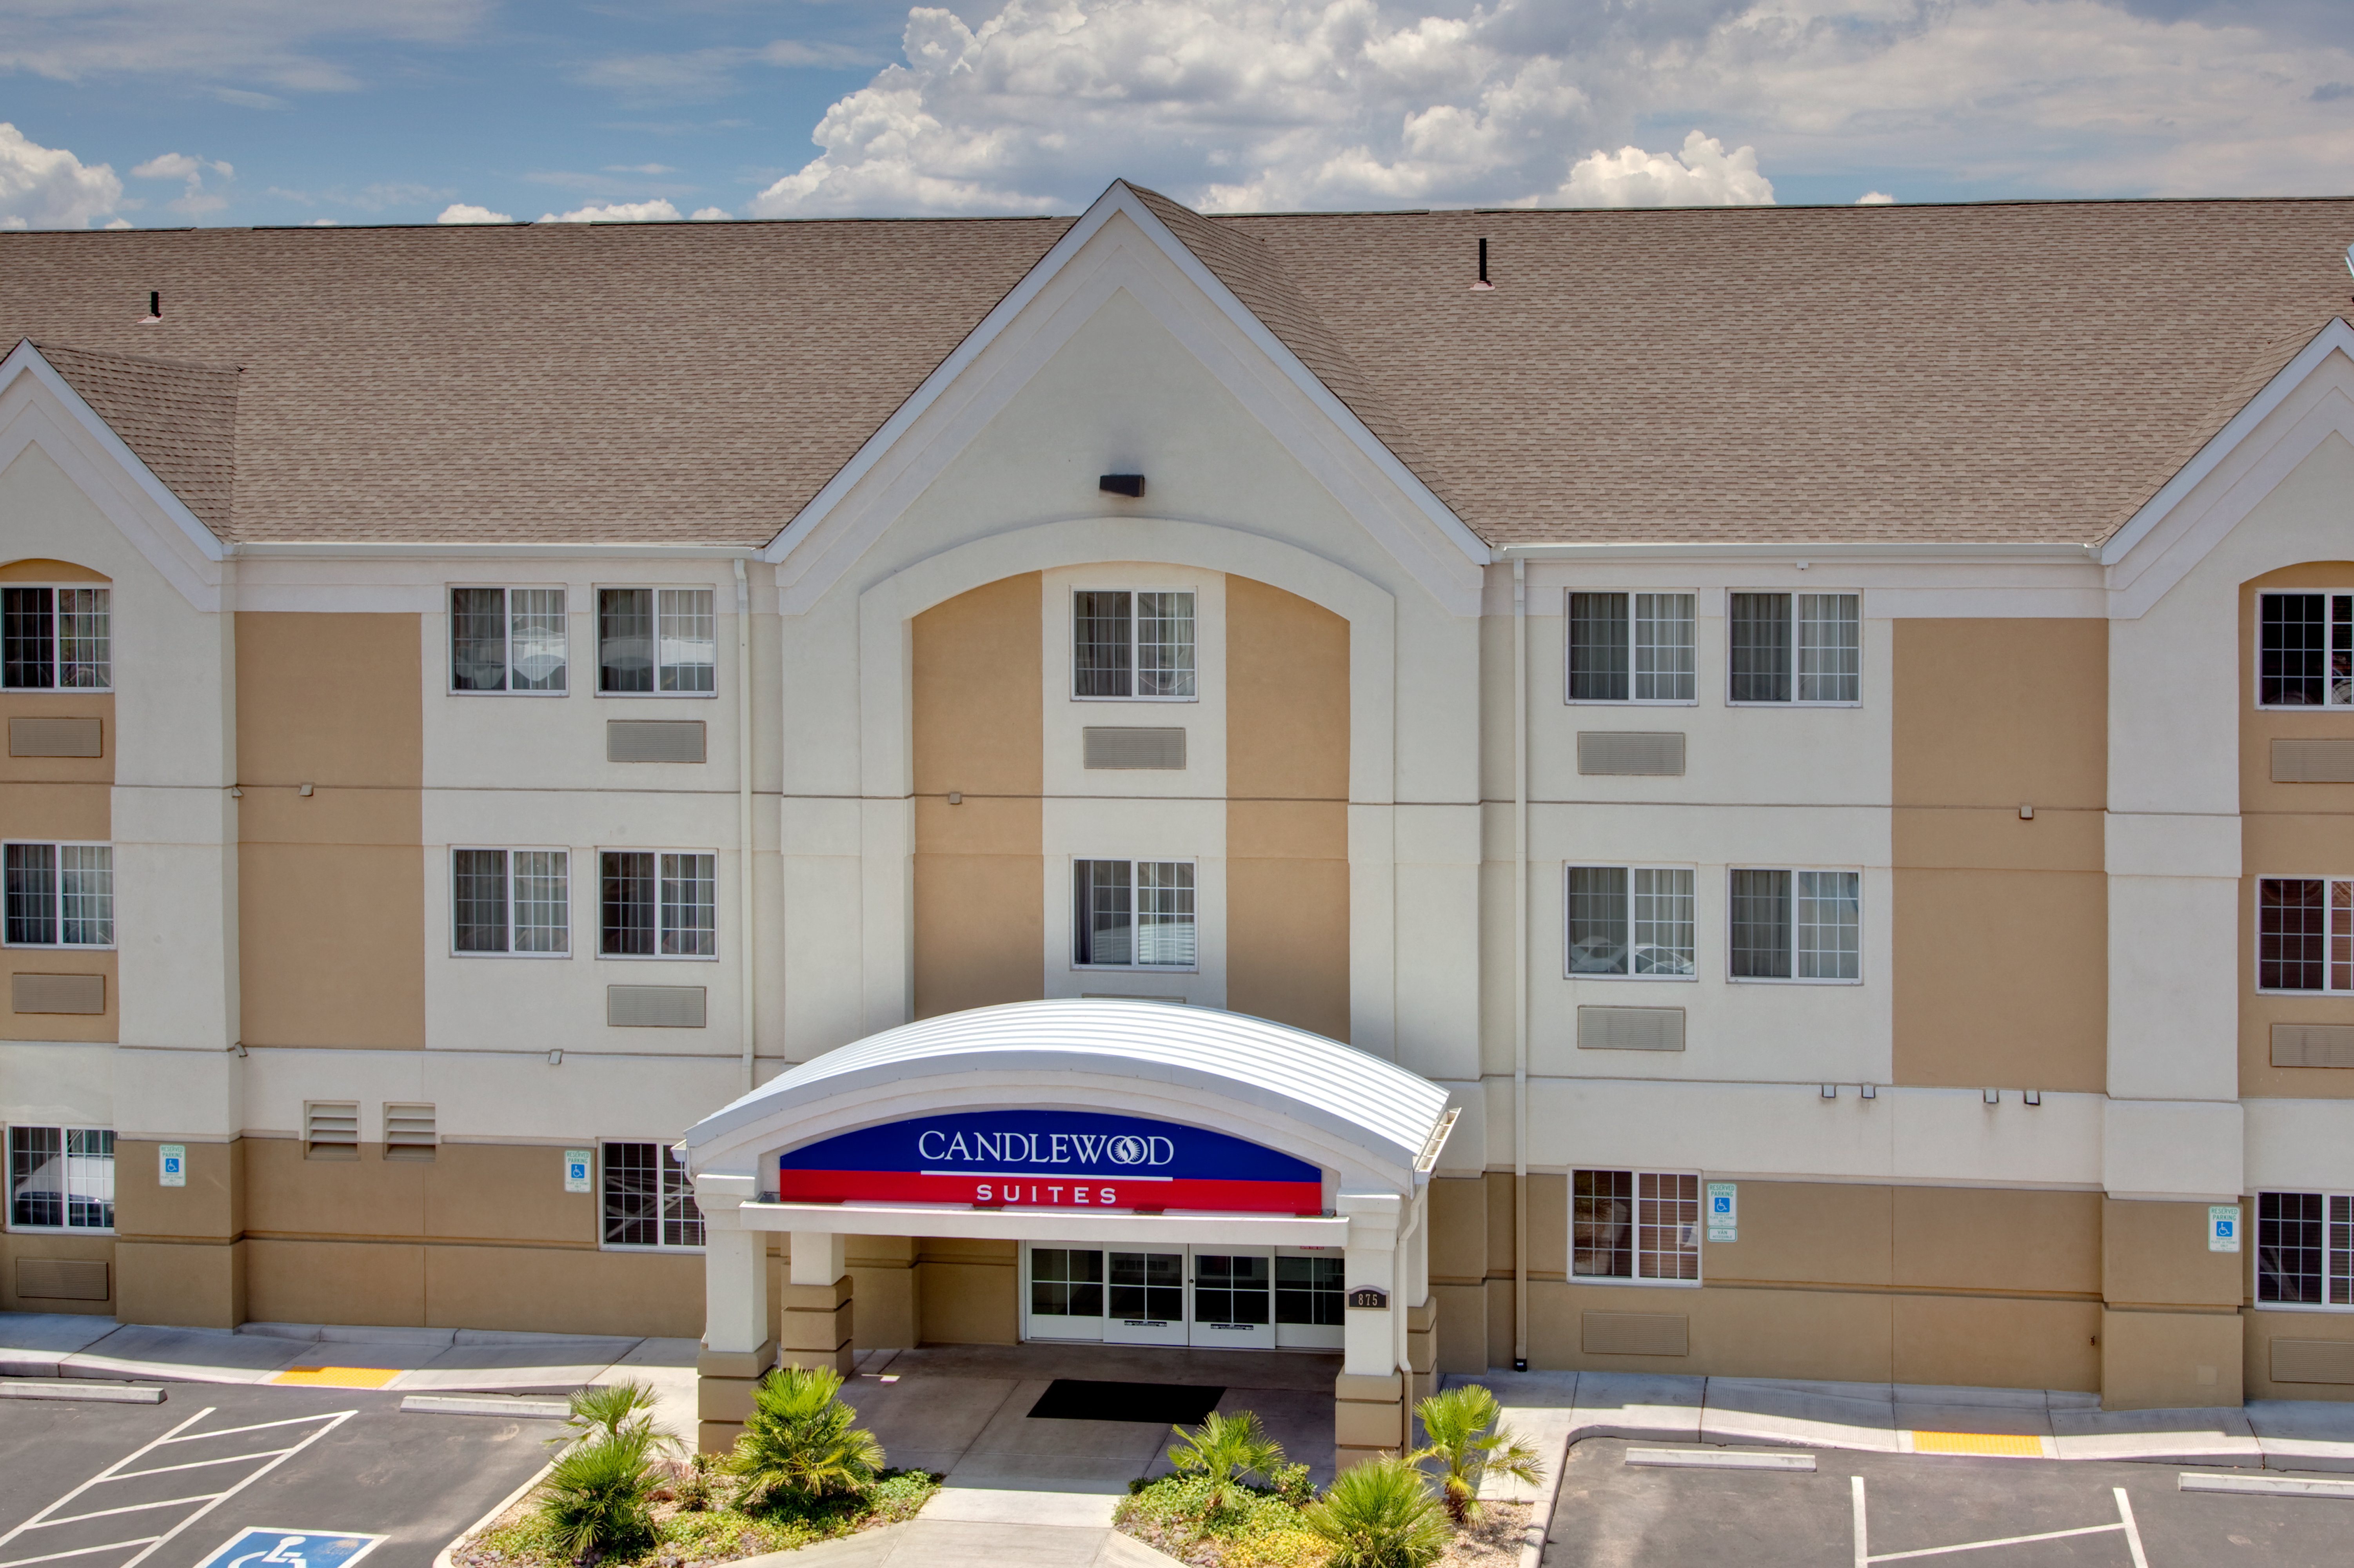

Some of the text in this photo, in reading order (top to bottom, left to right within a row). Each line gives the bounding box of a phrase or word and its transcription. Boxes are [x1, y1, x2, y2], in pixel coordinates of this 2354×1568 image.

[919, 1131, 1174, 1165] CANDLEWOOD
[977, 1184, 1116, 1204] SUITES
[1359, 1294, 1377, 1306] 875
